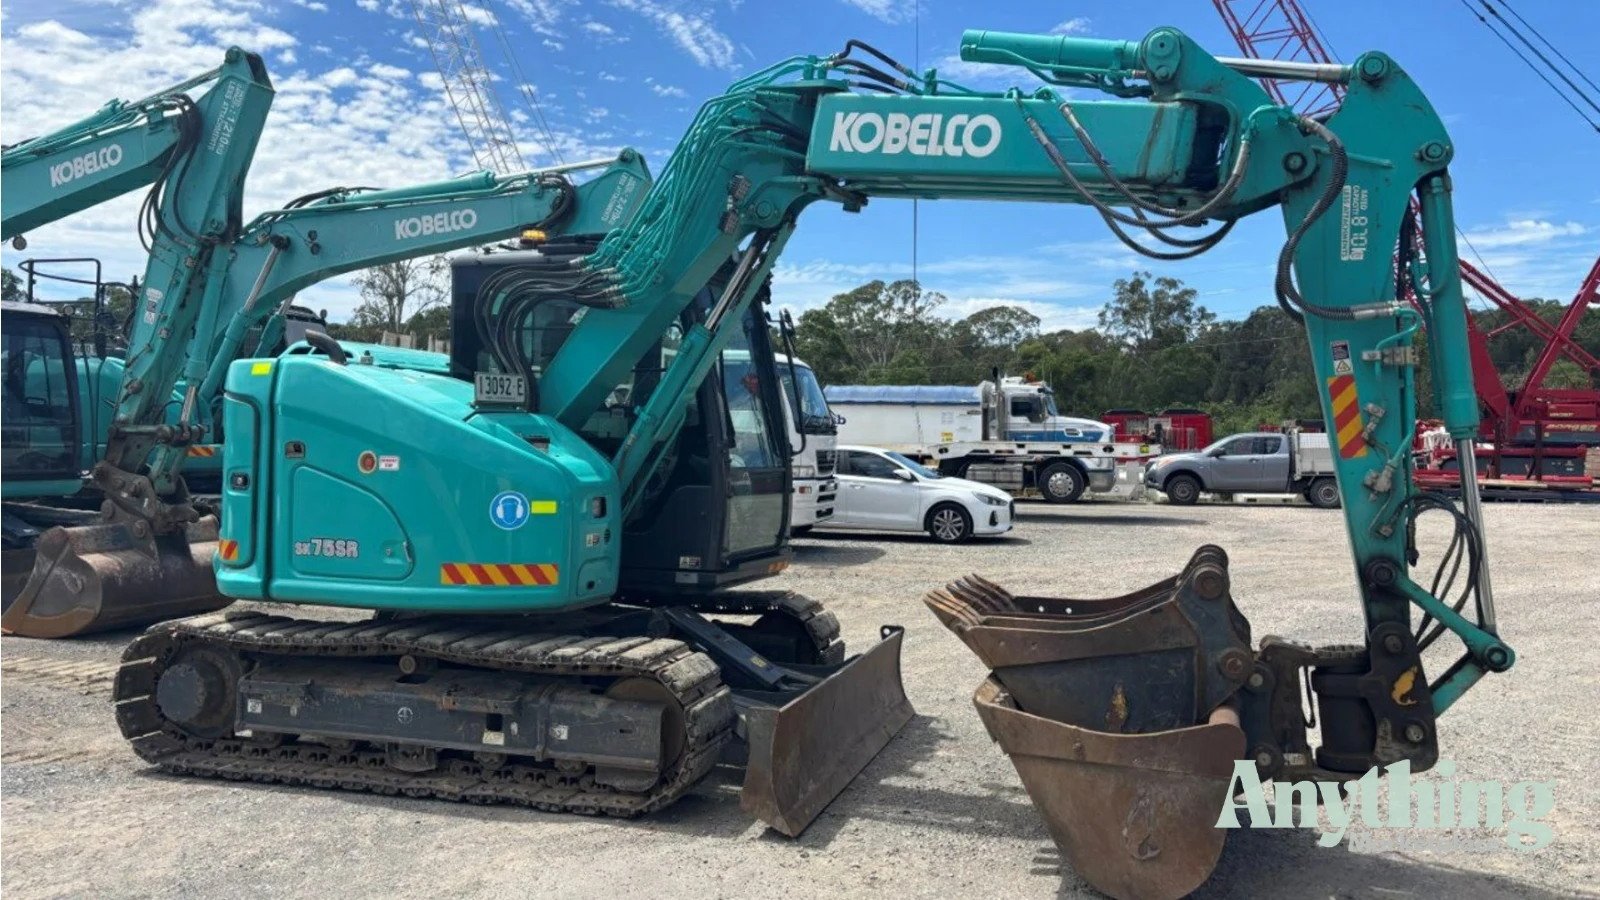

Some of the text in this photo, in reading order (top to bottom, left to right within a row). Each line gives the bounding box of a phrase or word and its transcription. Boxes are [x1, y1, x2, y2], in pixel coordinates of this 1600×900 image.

[829, 107, 1002, 158] KOBELCO
[50, 144, 122, 188] KOBELCO
[394, 209, 477, 240] KOBELCO
